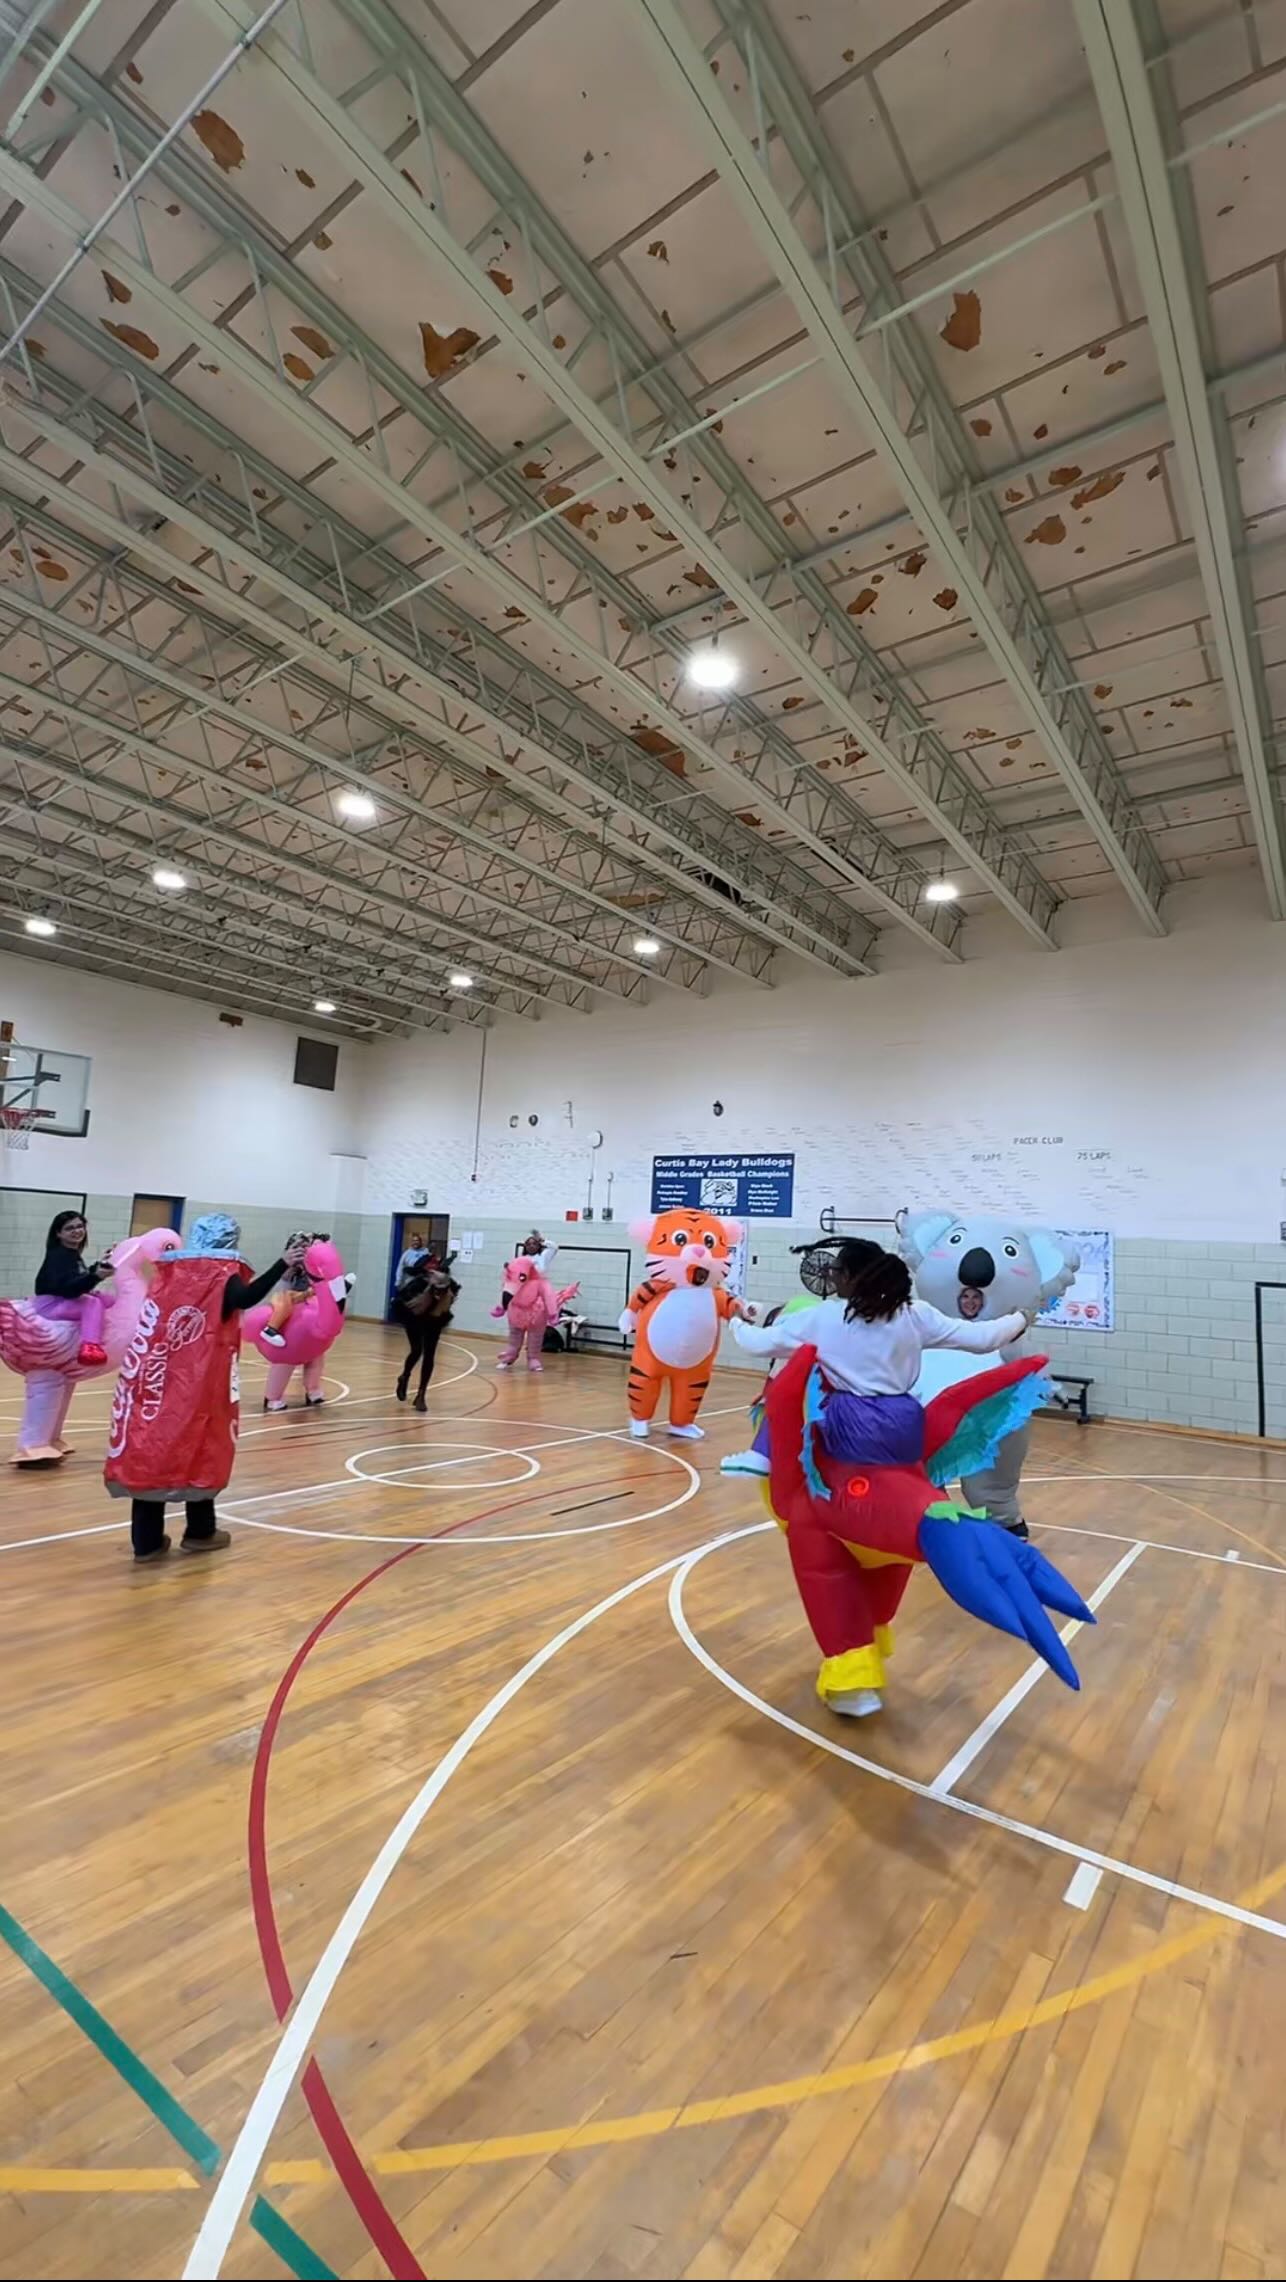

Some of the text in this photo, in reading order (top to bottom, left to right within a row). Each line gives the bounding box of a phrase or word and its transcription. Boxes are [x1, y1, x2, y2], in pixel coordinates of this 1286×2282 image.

[1041, 1136, 1063, 1144] CLUB
[655, 1157, 792, 1169] Curtis Bay Lady Bulldogs
[707, 1170, 746, 1178] Basketball
[747, 1170, 789, 1179] Champions
[140, 1342, 169, 1420] CLASSIC
